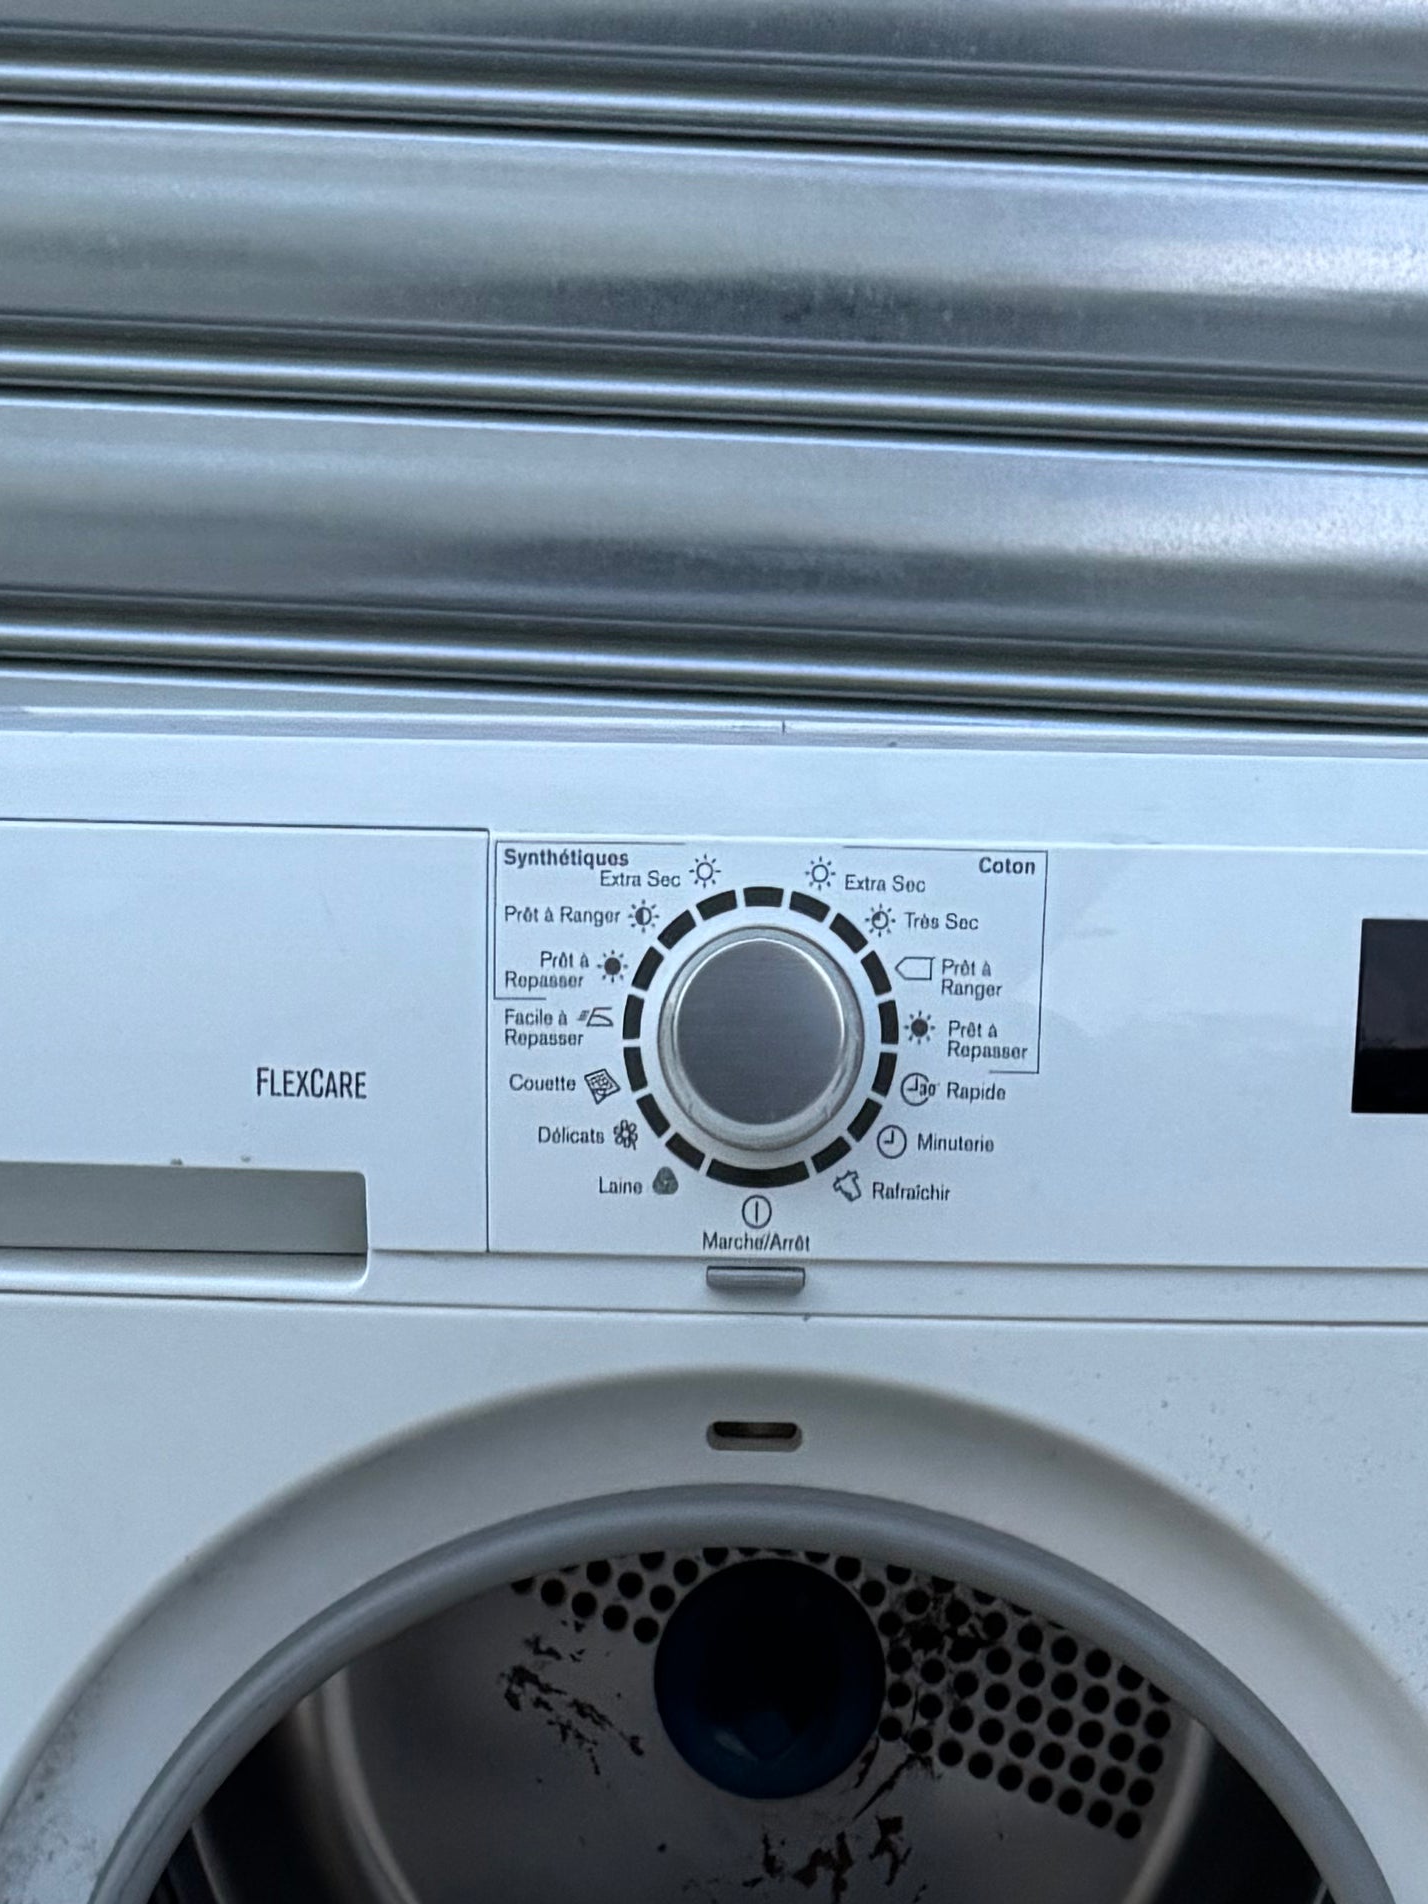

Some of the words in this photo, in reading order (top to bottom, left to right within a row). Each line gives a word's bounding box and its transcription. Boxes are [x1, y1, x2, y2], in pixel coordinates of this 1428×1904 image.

[503, 848, 629, 872] Synthétiques
[978, 856, 1036, 875] Coton
[600, 869, 642, 888] Extra
[647, 869, 681, 888] Sec
[844, 873, 887, 892] Extra
[891, 874, 926, 893] Sec
[504, 905, 539, 923] Prêt
[543, 906, 555, 923] à
[560, 905, 621, 928] Ranger
[904, 911, 940, 930] Très
[945, 912, 979, 931] Sec
[540, 950, 574, 969] Prêt
[579, 952, 590, 969] à
[941, 958, 976, 980] Prêt
[981, 960, 992, 977] à
[504, 970, 584, 992] Repasser
[940, 978, 1003, 1002] Ranger
[504, 1007, 554, 1026] Facile
[557, 1009, 568, 1027] à
[504, 1028, 584, 1050] Repasser
[948, 1019, 982, 1038] Prêt
[987, 1023, 998, 1039] à
[947, 1040, 1028, 1063] Repasser
[256, 1066, 367, 1100] FLEXCARE
[508, 1073, 577, 1092] Couette
[946, 1081, 1006, 1104] Rapide
[538, 1125, 605, 1145] Délicats
[917, 1132, 995, 1153] Minuterie
[598, 1175, 643, 1195] Laine
[872, 1181, 951, 1201] Rafraîchir
[702, 1231, 810, 1253] Marche/Arrêt
